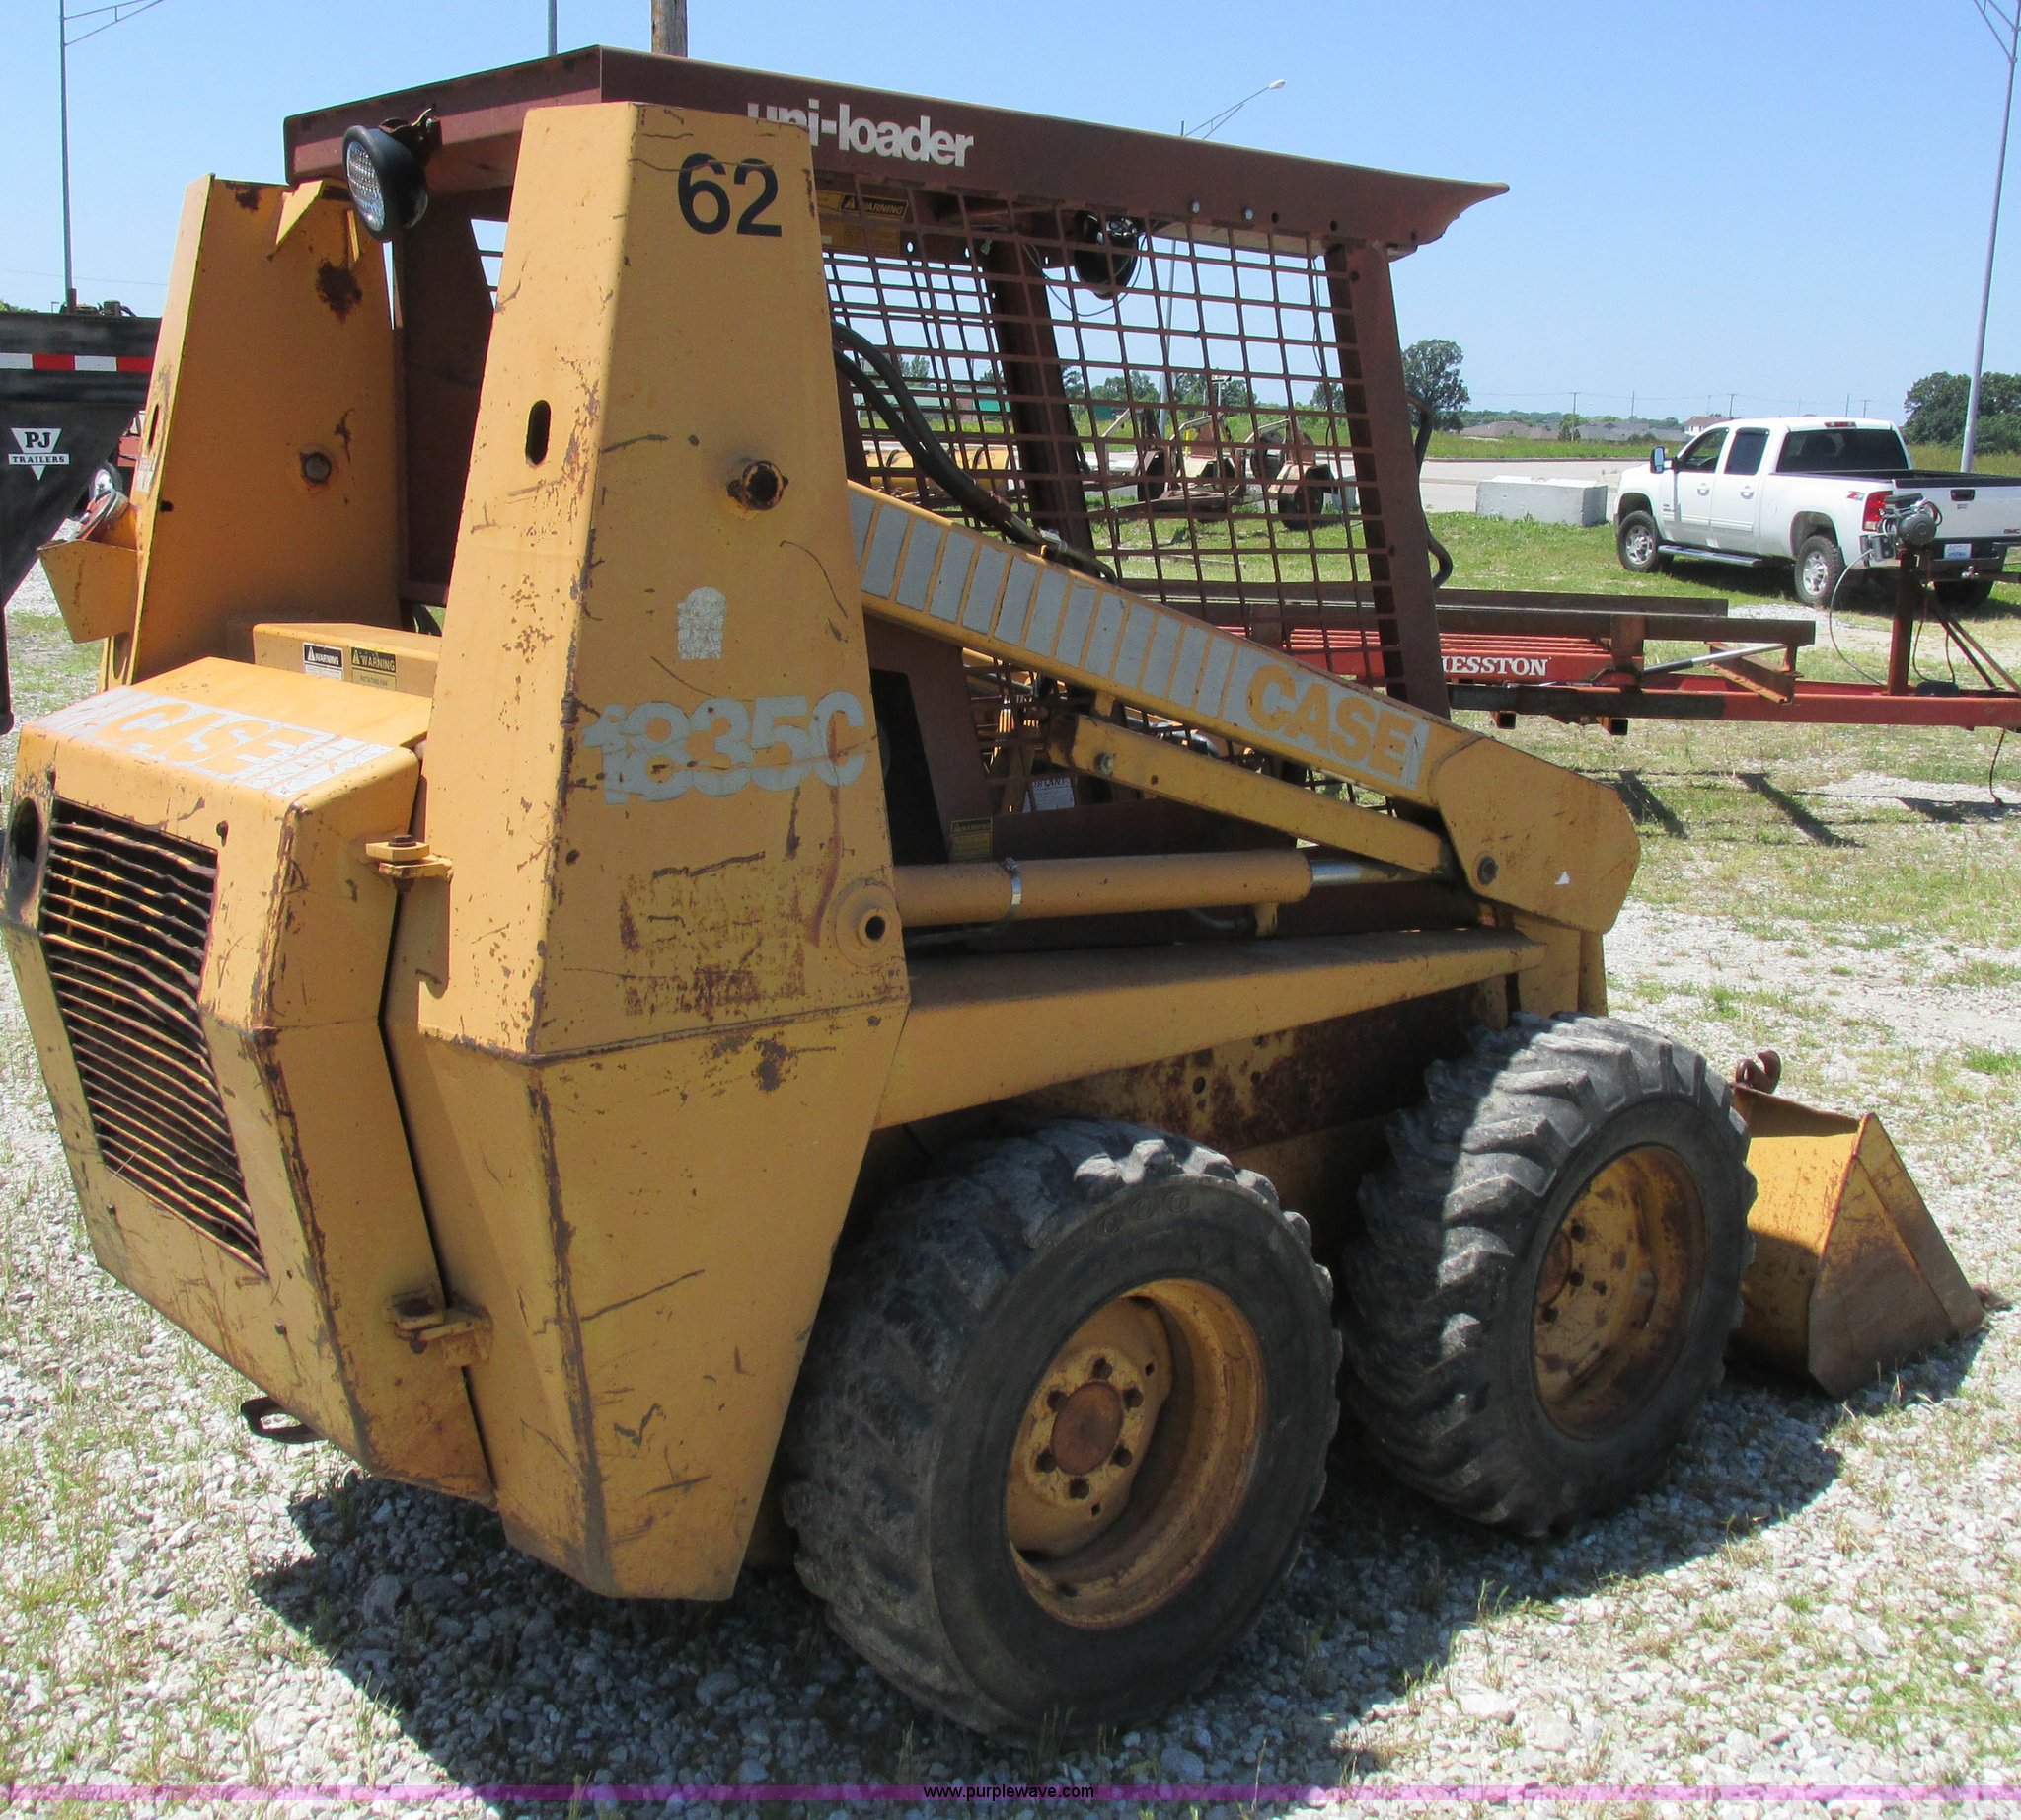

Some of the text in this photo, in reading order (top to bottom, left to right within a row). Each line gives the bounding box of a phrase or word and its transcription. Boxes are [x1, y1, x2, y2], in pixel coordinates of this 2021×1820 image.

[678, 153, 783, 238] 62
[865, 201, 904, 215] ARNING
[25, 431, 51, 448] PJ
[315, 653, 339, 666] WARNING
[361, 653, 396, 671] WARNING
[106, 702, 315, 775] CASE
[1249, 666, 1415, 776] CASE
[581, 691, 867, 805] 1835C
